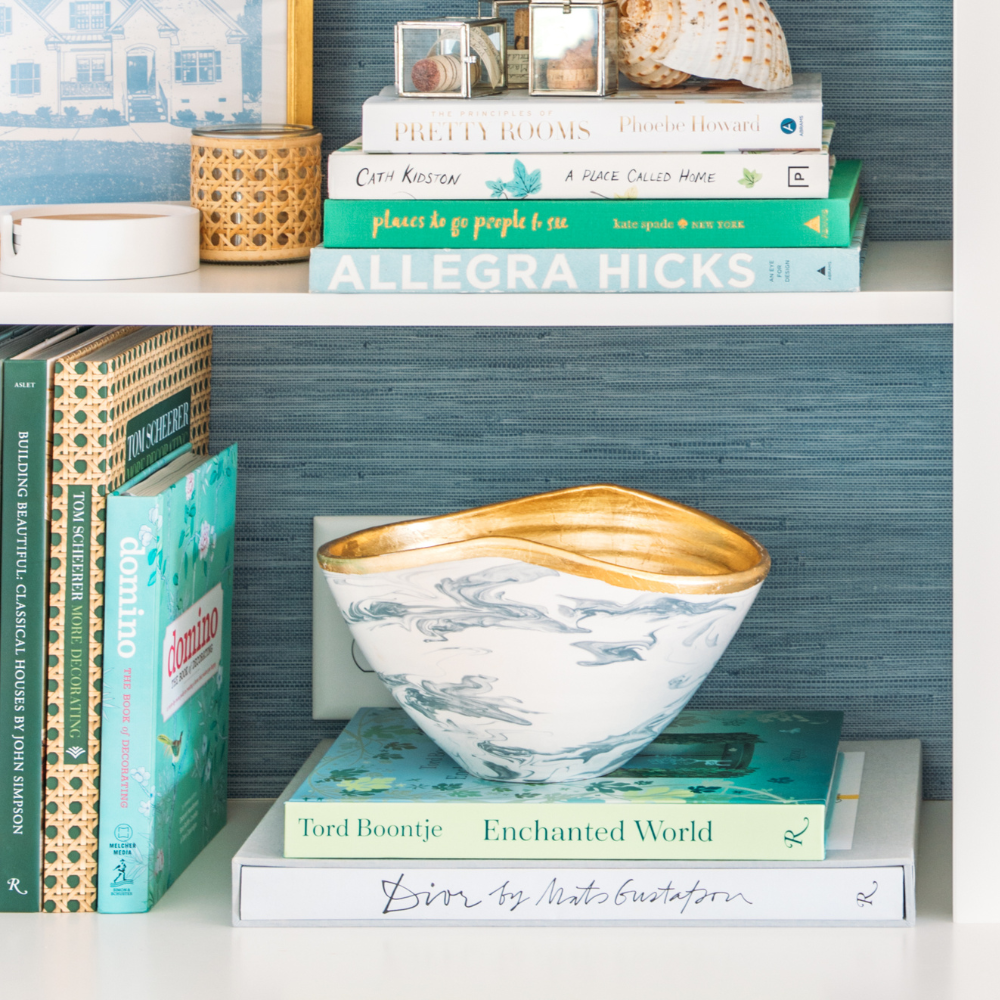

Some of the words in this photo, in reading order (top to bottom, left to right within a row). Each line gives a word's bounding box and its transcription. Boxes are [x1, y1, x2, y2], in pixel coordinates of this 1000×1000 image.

[394, 121, 488, 142] PRETTY
[500, 119, 591, 141] ROOMS
[619, 115, 686, 133] Phoebe
[690, 114, 761, 133] Howard
[356, 167, 394, 186] CATH
[401, 164, 462, 186] KIDSTON
[565, 169, 574, 182] A
[582, 169, 620, 183] PLACE
[627, 169, 672, 183] CALLED
[678, 169, 716, 183] HOME
[372, 209, 425, 239] places
[429, 210, 447, 228] to
[451, 217, 468, 238] go
[473, 208, 527, 240] people
[547, 217, 569, 231] see
[612, 218, 638, 229] kate
[641, 218, 675, 232] spade
[691, 220, 713, 229] NEW
[717, 220, 745, 229] YORK
[327, 252, 579, 290] ALLEGRA
[599, 252, 756, 289] HICKS
[146, 402, 189, 449] SCHEERER
[17, 431, 29, 498] BUILDING
[73, 491, 85, 523] TOM
[16, 501, 28, 581] BEAUTIFUL:
[71, 526, 85, 601] SCHEERER
[117, 536, 145, 659] domino
[14, 583, 27, 656] CLASSICAL
[71, 605, 83, 645] MORE
[168, 607, 219, 677] domino
[14, 659, 26, 712] HOUSES
[69, 649, 83, 739] DECORATING
[123, 667, 132, 690] THE
[14, 716, 25, 732] BY
[122, 694, 131, 723] BOOK
[120, 726, 131, 735] of
[12, 734, 24, 771] JOHN
[120, 739, 130, 809] DECORATING
[12, 776, 24, 835] SIMPSON
[298, 818, 349, 838] Tord
[357, 817, 443, 843] Boontje
[483, 819, 625, 842] Enchanted
[633, 819, 713, 842] World
[381, 873, 483, 914] Dior
[488, 880, 531, 912] by
[614, 878, 753, 915] Gustafson
